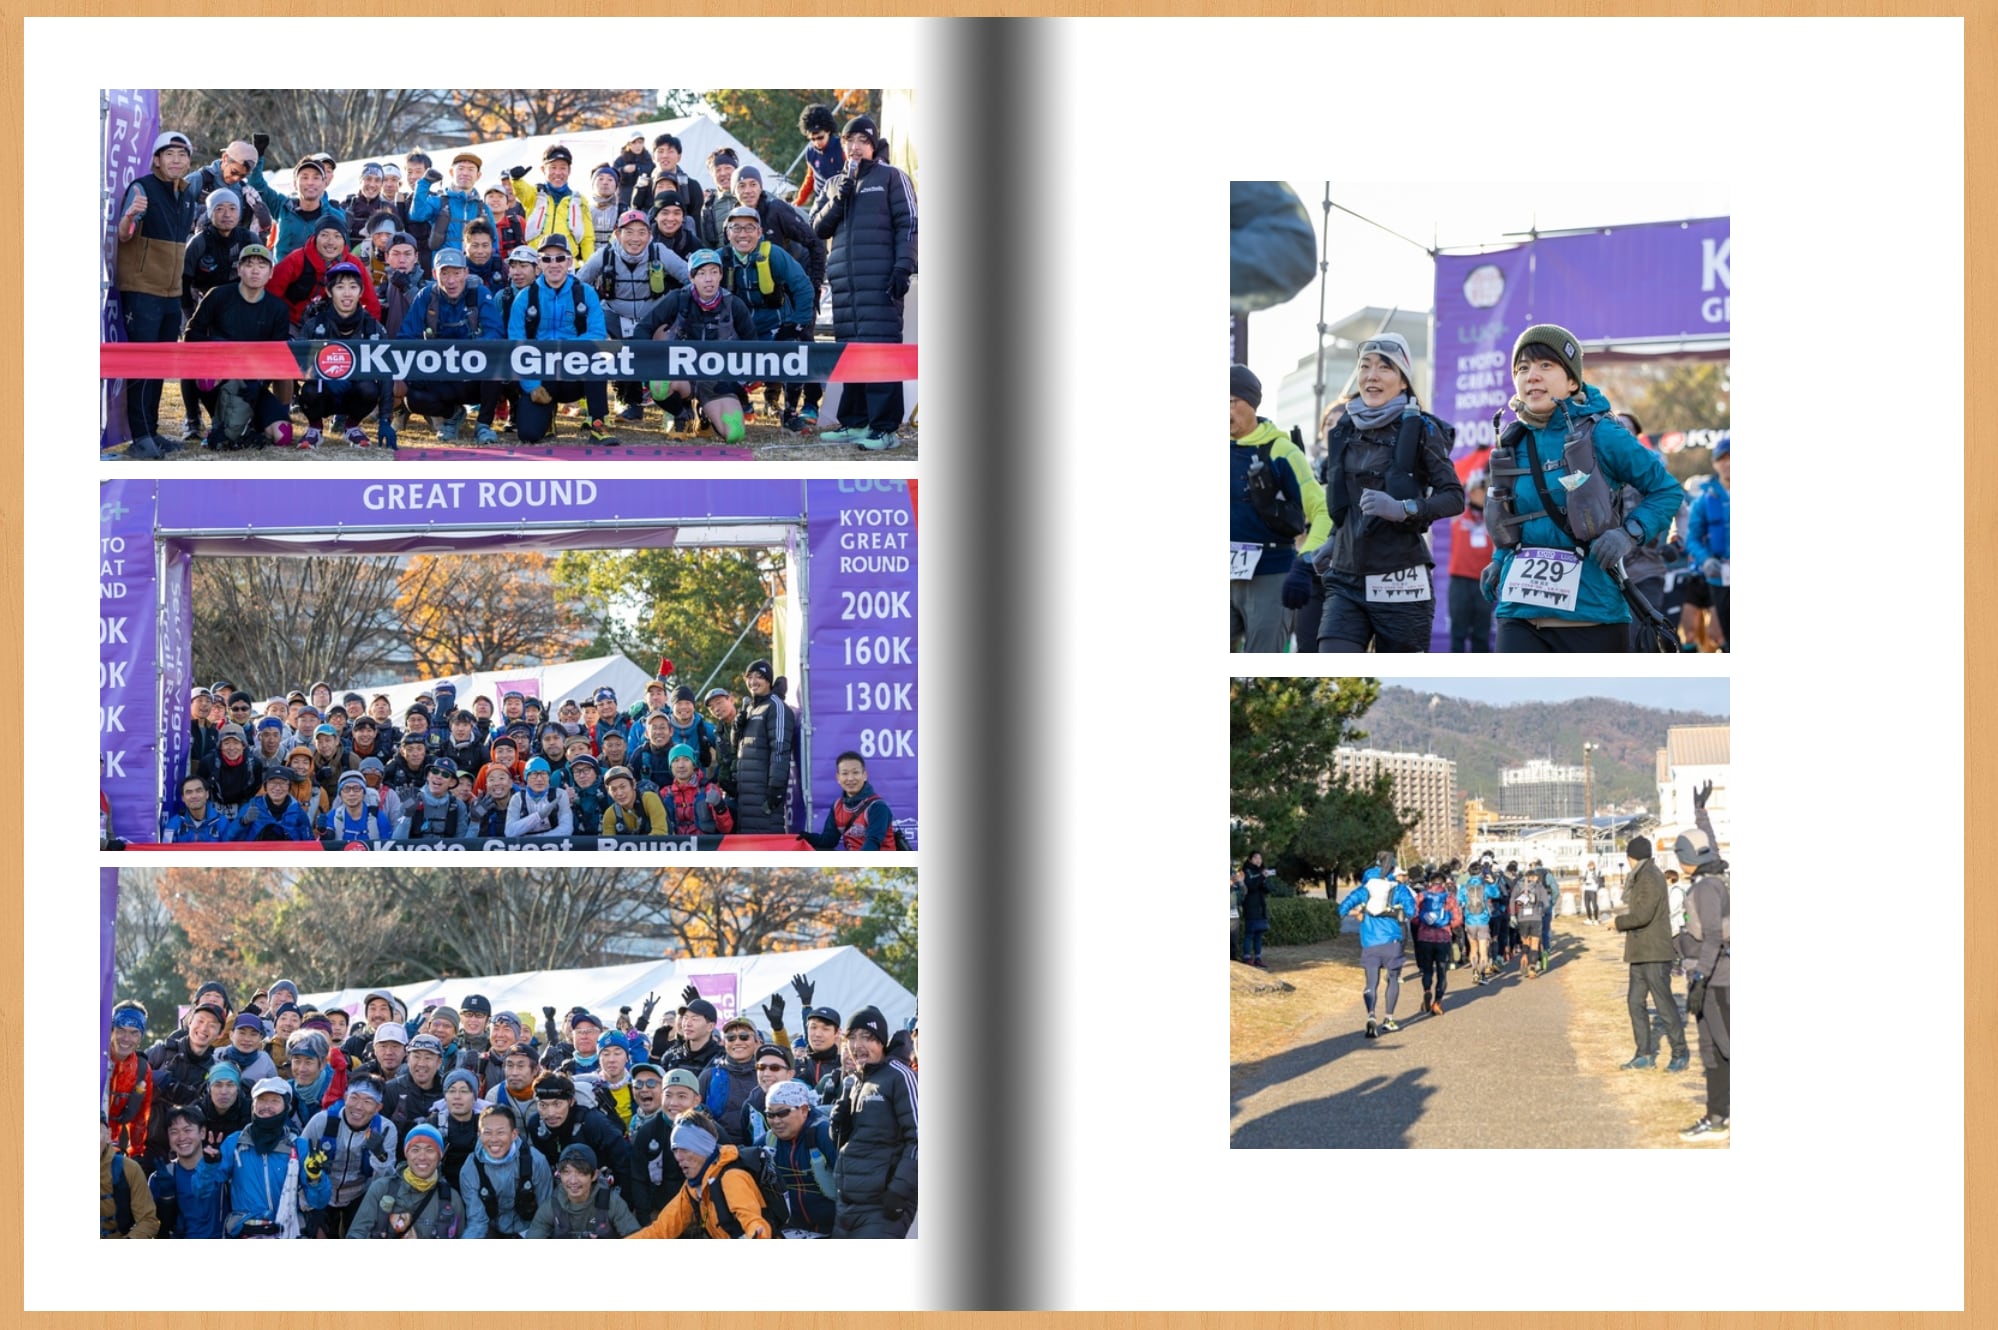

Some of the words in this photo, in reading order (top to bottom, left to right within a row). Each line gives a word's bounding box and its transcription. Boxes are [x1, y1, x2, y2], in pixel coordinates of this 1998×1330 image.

[360, 344, 487, 380] Kyoto
[510, 345, 635, 375] Great
[668, 345, 809, 376] Round
[1457, 351, 1506, 372] KYOTO
[1456, 371, 1504, 390] GREAT
[1456, 391, 1507, 410] ROUND
[363, 483, 465, 510] GREAT
[478, 480, 598, 508] ROUND
[840, 509, 909, 526] KYOTO
[841, 532, 909, 550] GREAT
[840, 555, 910, 573] ROUND
[1520, 559, 1564, 583] 229
[841, 591, 912, 620] 200K
[844, 636, 912, 665] 160K
[846, 682, 913, 711] 130K
[860, 729, 915, 758] 80K
